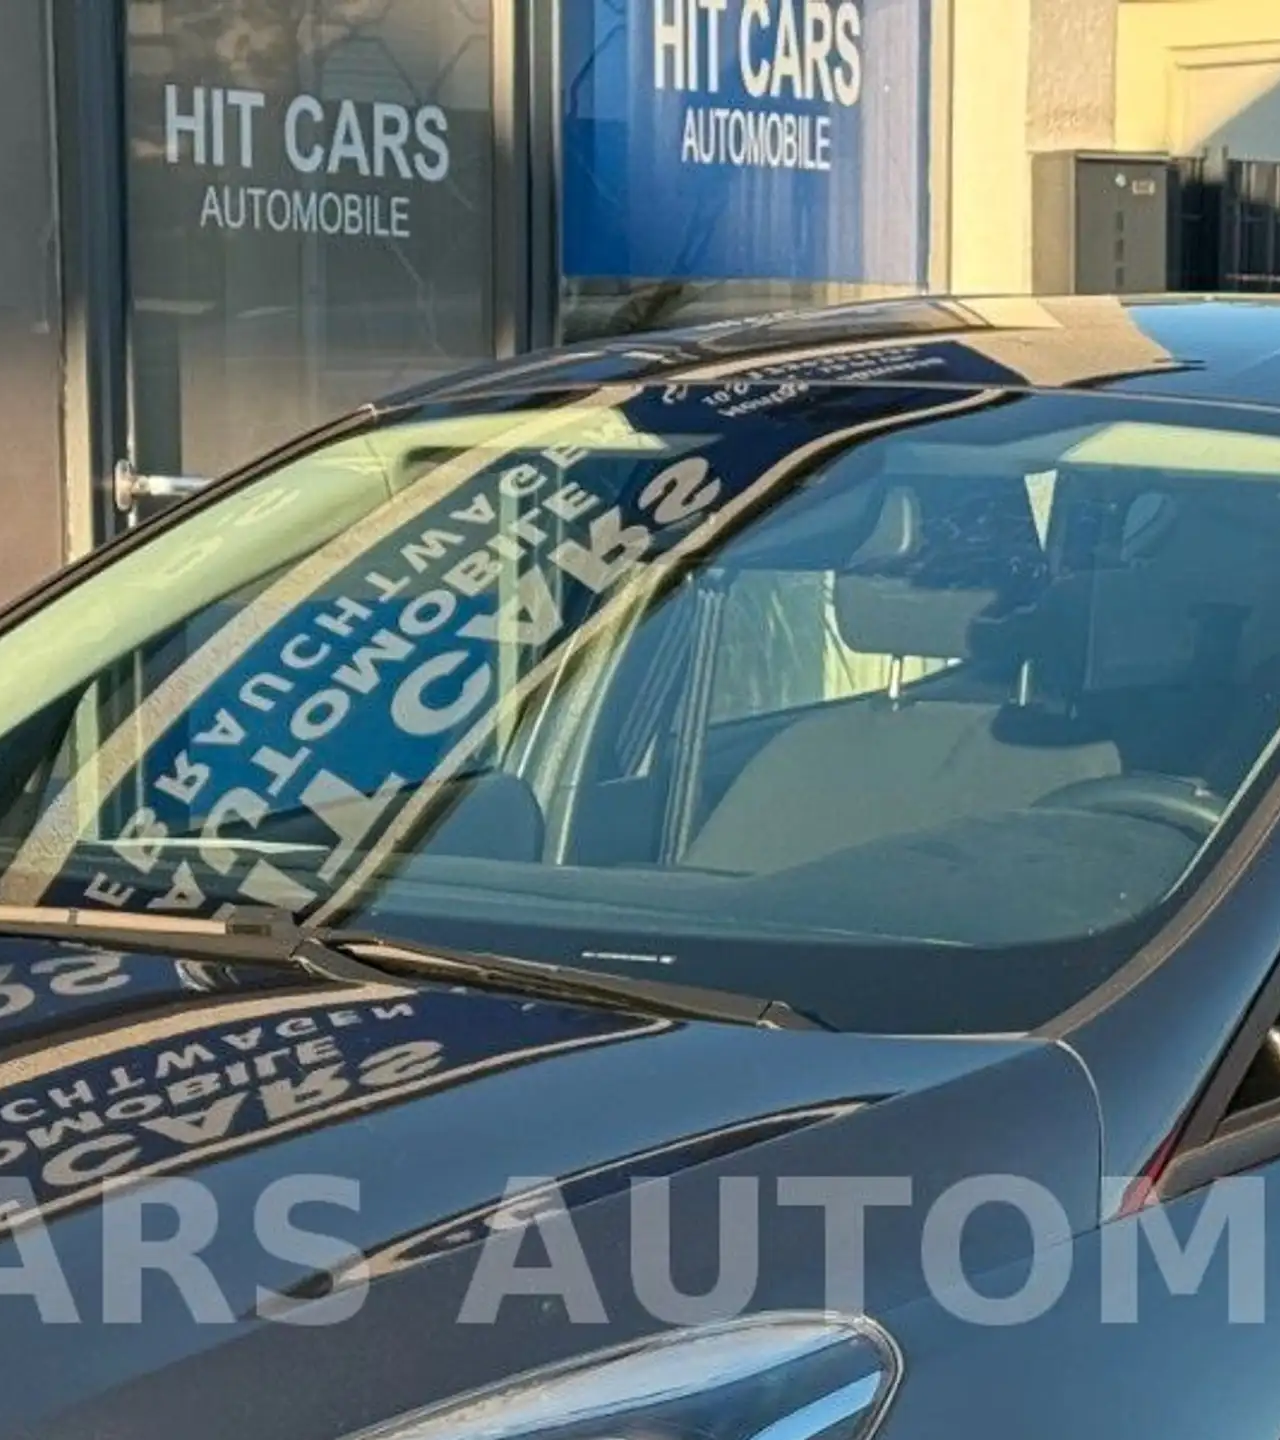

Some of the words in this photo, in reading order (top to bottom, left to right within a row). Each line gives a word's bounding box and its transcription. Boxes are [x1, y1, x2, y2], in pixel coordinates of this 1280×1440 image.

[654, 0, 727, 93] HIT
[739, 0, 861, 107] CARS
[165, 84, 265, 169] HIT
[284, 94, 451, 182] CARS
[681, 105, 832, 171] AUTOMOBILE
[199, 185, 411, 238] AUTOMOBILE
